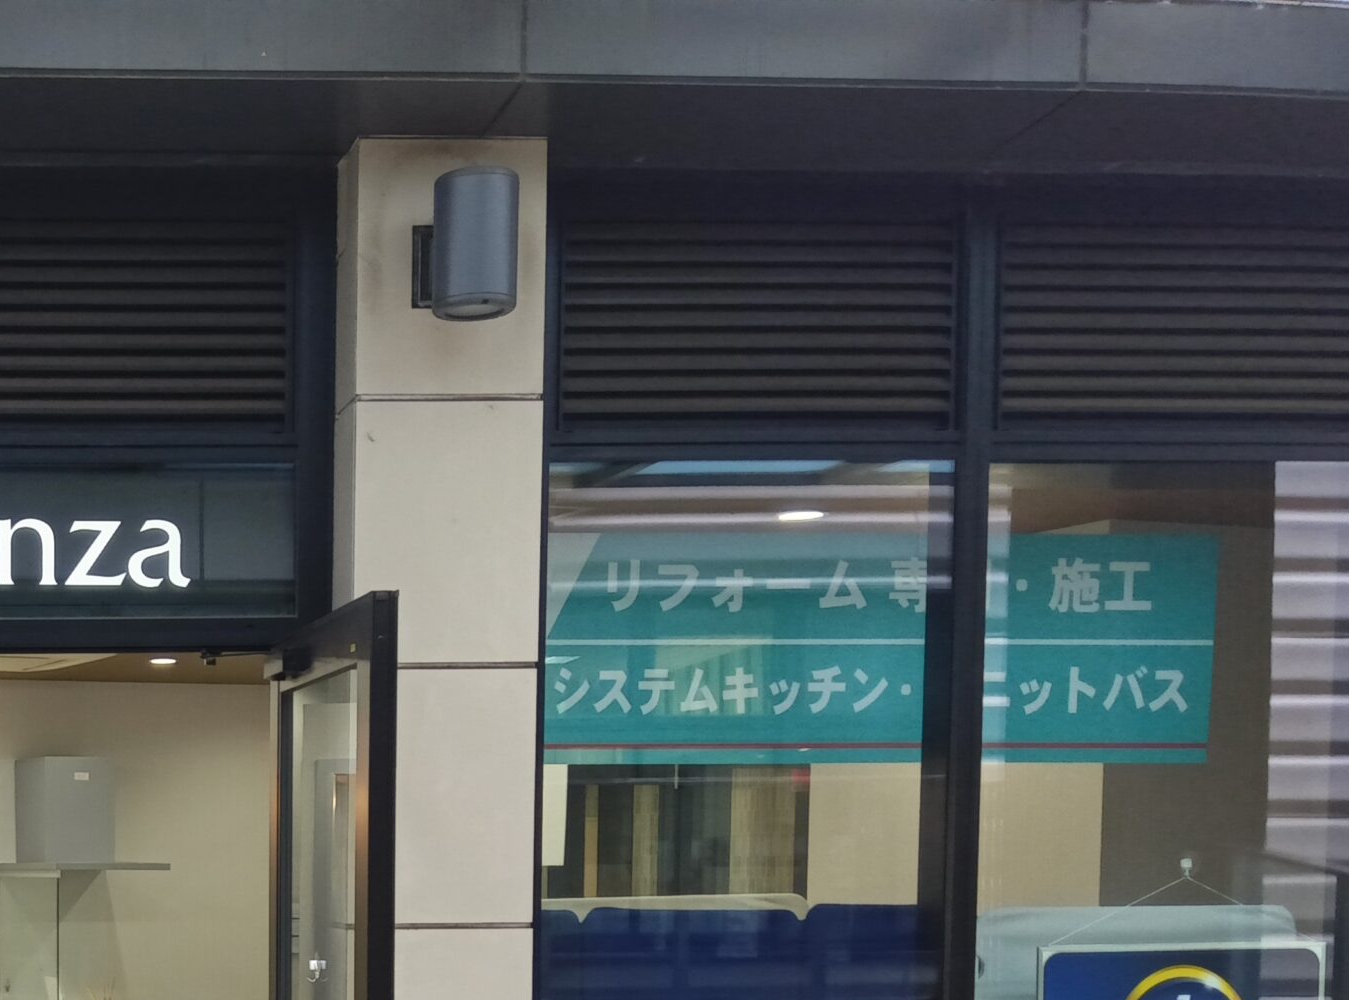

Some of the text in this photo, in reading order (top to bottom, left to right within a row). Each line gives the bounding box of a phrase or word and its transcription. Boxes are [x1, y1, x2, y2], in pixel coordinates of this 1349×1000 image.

[607, 557, 1152, 613] リフォーム 専・施工
[553, 665, 1189, 715] システムキッチン・ニットバス
